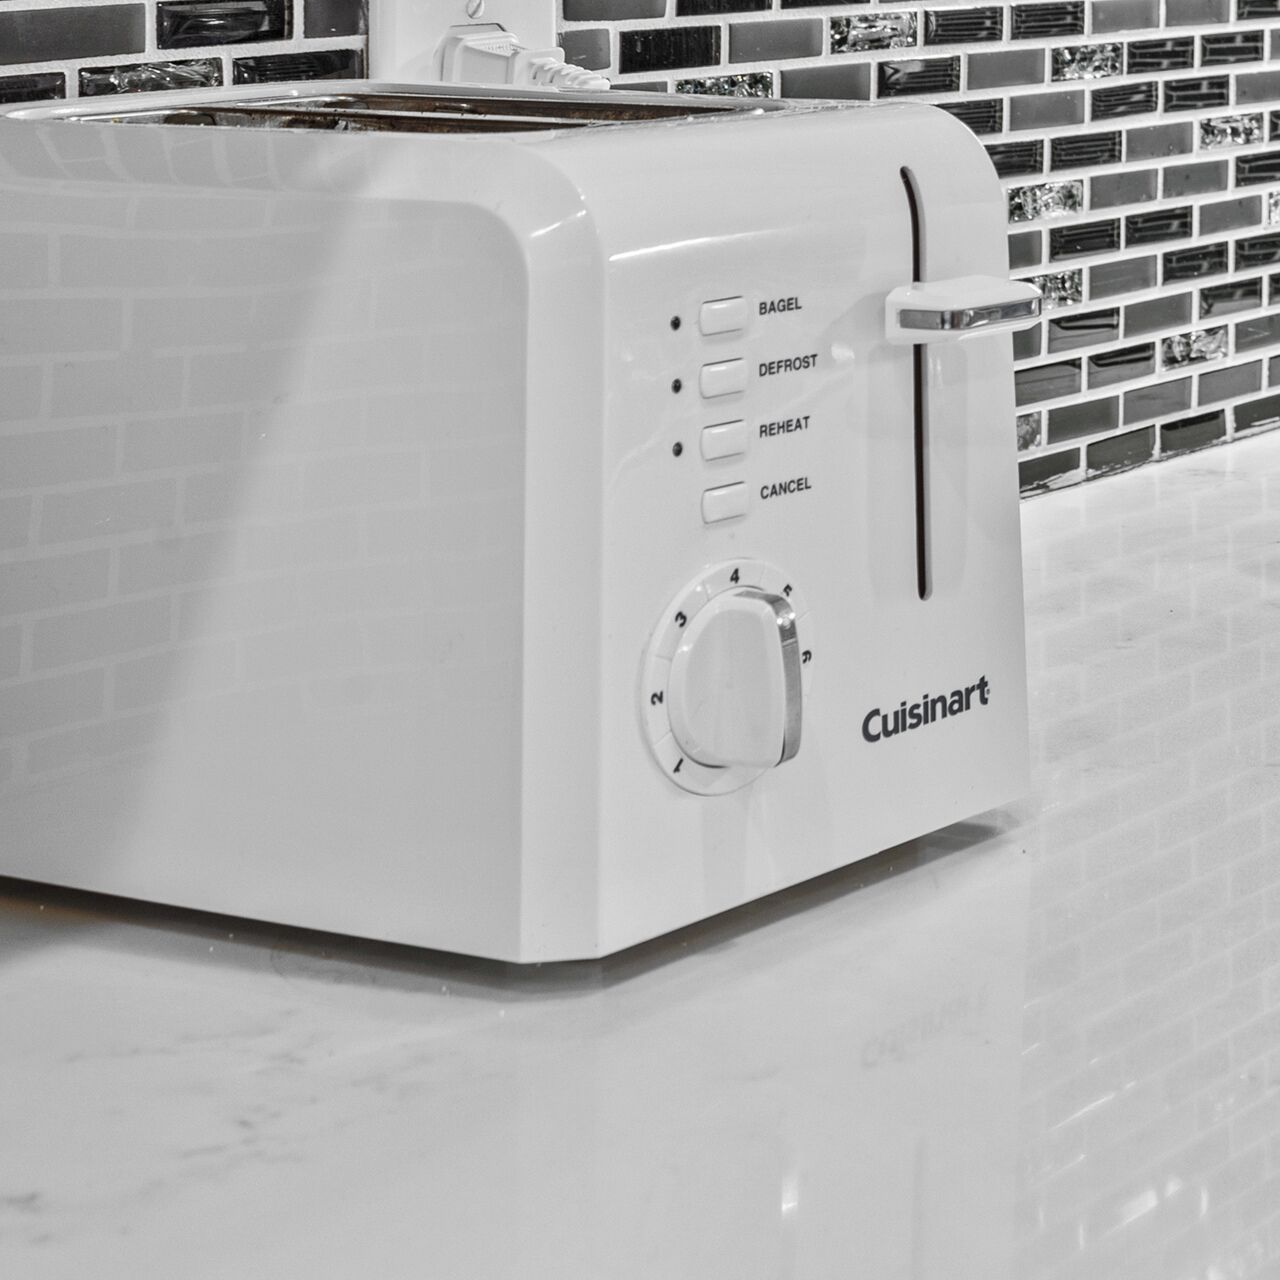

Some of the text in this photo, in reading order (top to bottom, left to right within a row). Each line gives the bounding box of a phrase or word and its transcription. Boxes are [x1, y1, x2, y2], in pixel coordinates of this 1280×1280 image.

[759, 297, 802, 315] BAGEL
[759, 353, 818, 377] DEFROST
[759, 415, 811, 438] REHEAT
[760, 477, 812, 499] CANCEL
[730, 568, 740, 584] 4
[675, 611, 687, 628] 3
[651, 690, 664, 705] 2
[861, 674, 989, 743] Cuisinart
[673, 757, 684, 773] 1
